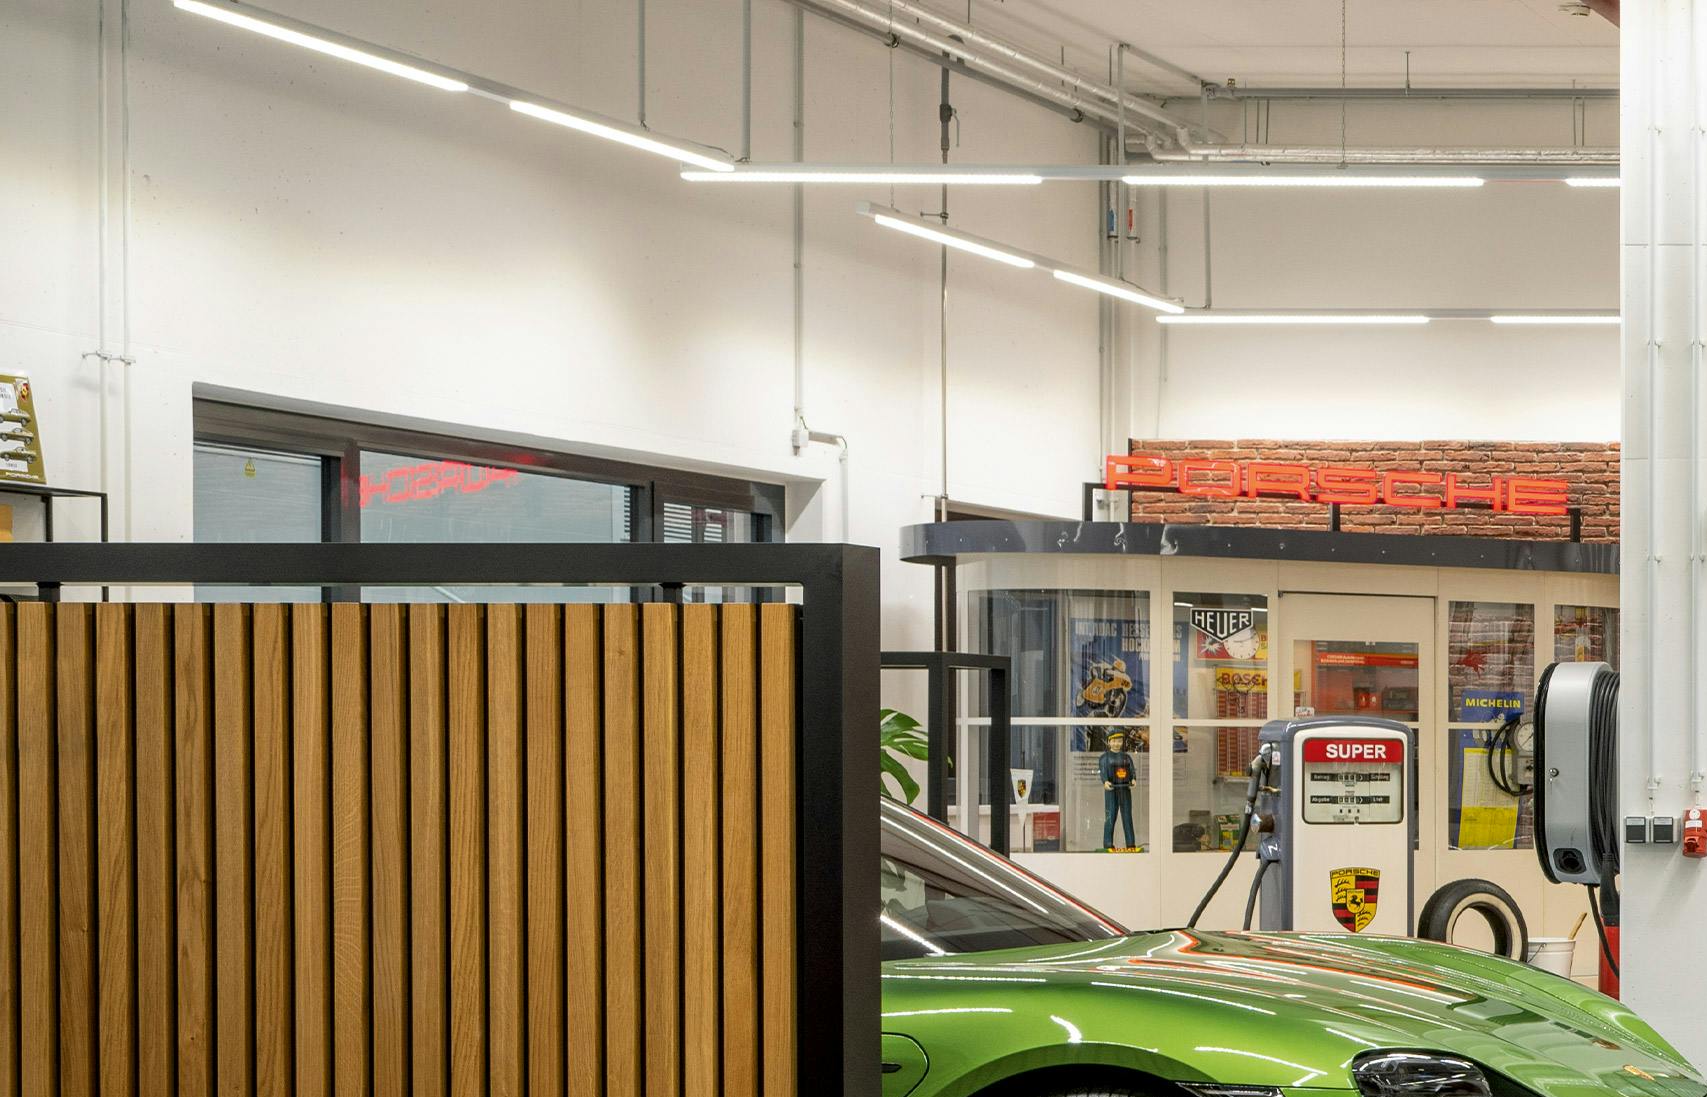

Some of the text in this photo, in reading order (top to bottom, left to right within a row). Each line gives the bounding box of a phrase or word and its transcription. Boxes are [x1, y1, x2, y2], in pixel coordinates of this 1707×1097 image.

[1105, 455, 1568, 516] PORSCHE
[1194, 611, 1250, 638] HEUER
[1465, 698, 1521, 708] MICHELIN
[1325, 743, 1387, 759] SUPER
[1332, 868, 1379, 877] PORSCHE
